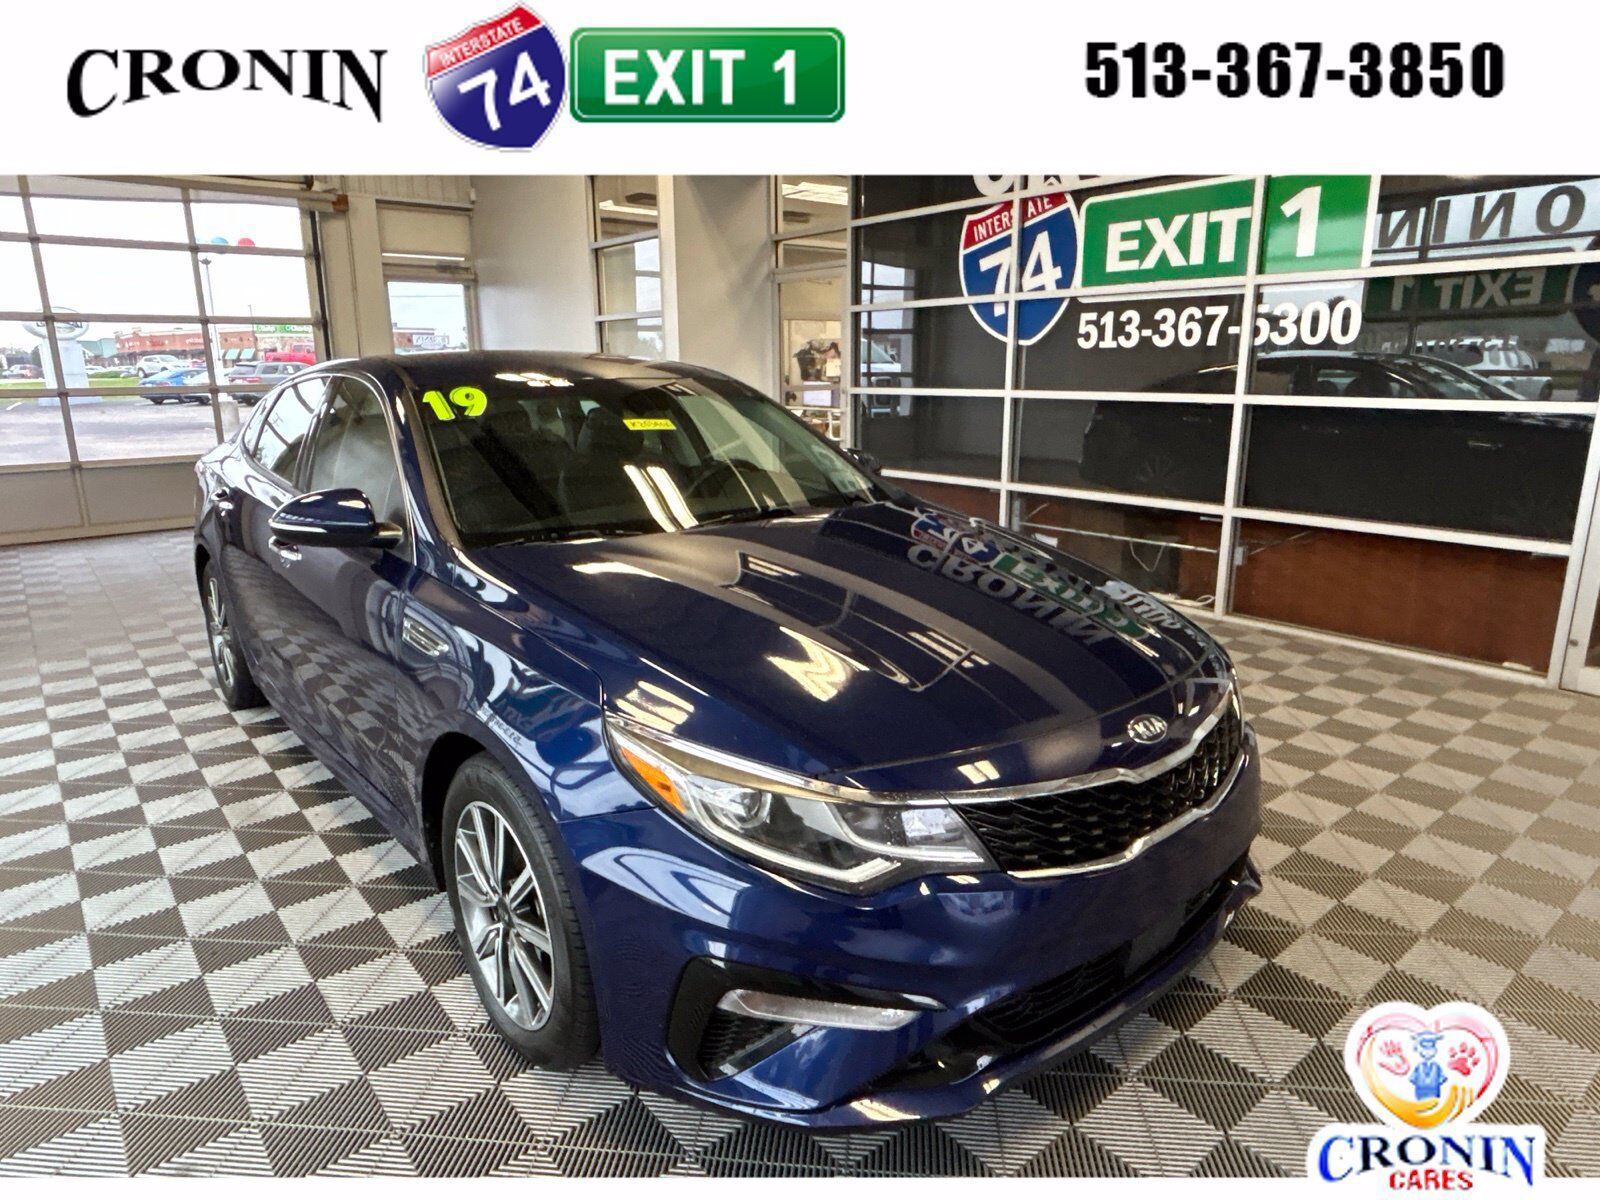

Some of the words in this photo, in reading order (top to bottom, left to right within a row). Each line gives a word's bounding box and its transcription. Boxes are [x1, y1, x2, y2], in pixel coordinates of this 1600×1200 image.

[973, 196, 1053, 243] INTERATE
[1105, 206, 1252, 273] EXIT
[1279, 185, 1322, 258] 1
[979, 231, 1063, 317] 74
[1077, 299, 1363, 350] 513-367-5300
[422, 386, 488, 421] 19
